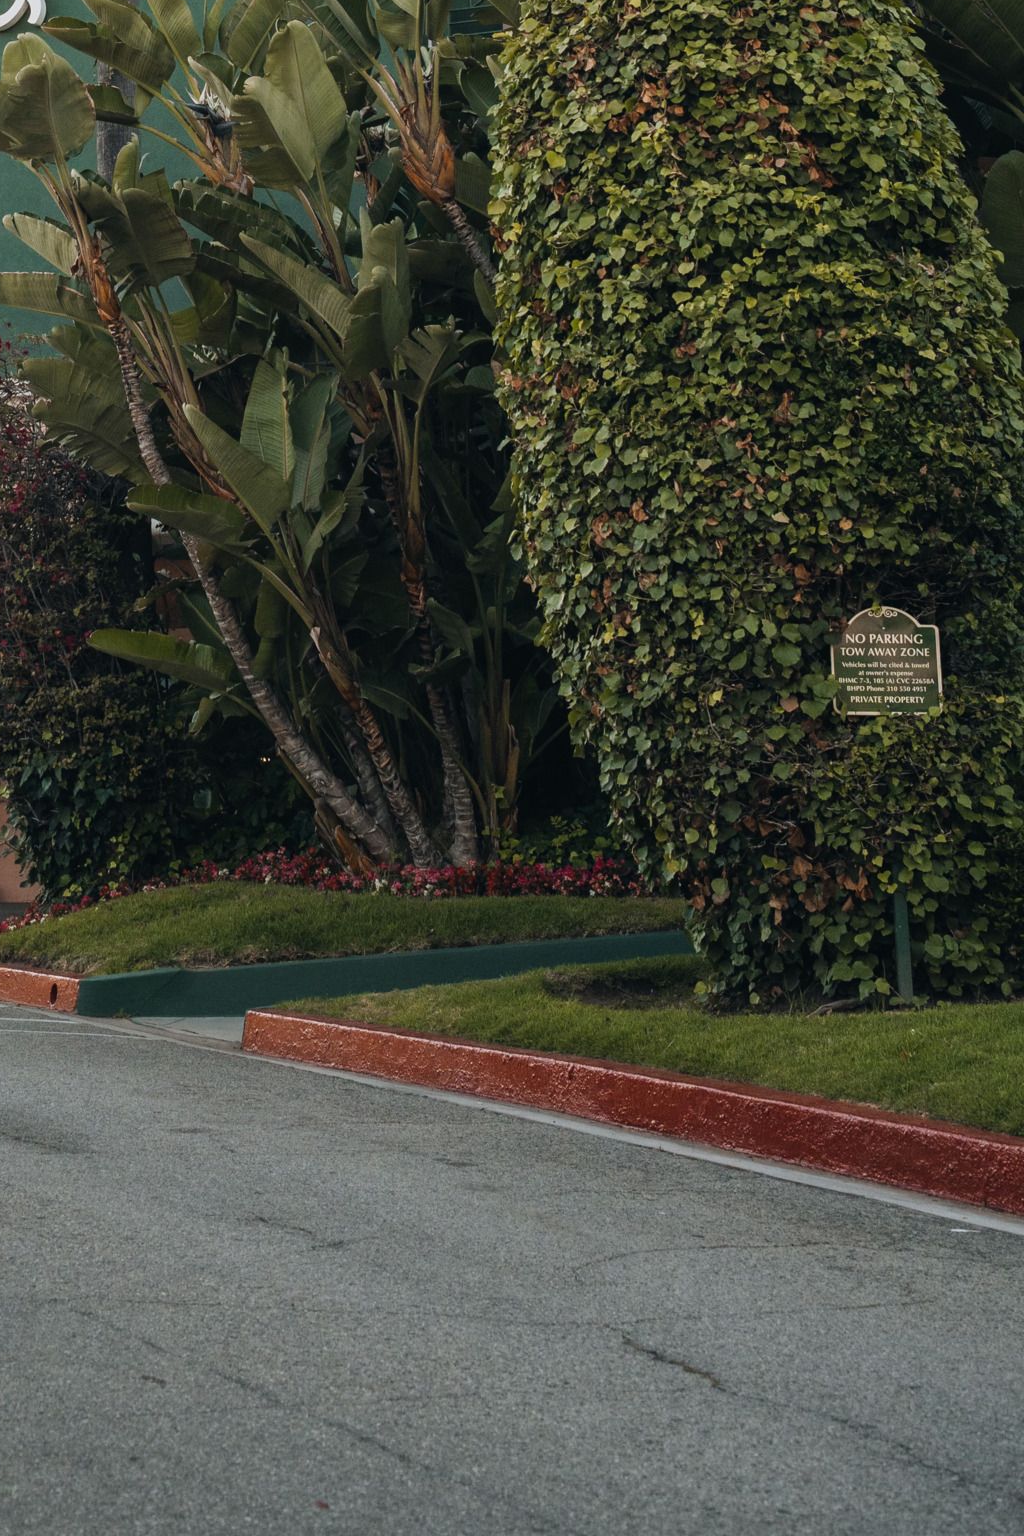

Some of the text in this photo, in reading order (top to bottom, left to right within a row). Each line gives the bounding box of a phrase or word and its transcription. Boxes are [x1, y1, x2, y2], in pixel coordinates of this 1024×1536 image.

[845, 633, 924, 645] NO PARKING
[840, 647, 930, 657] TOW AWAY ZONE
[884, 696, 925, 704] PROPERTY
